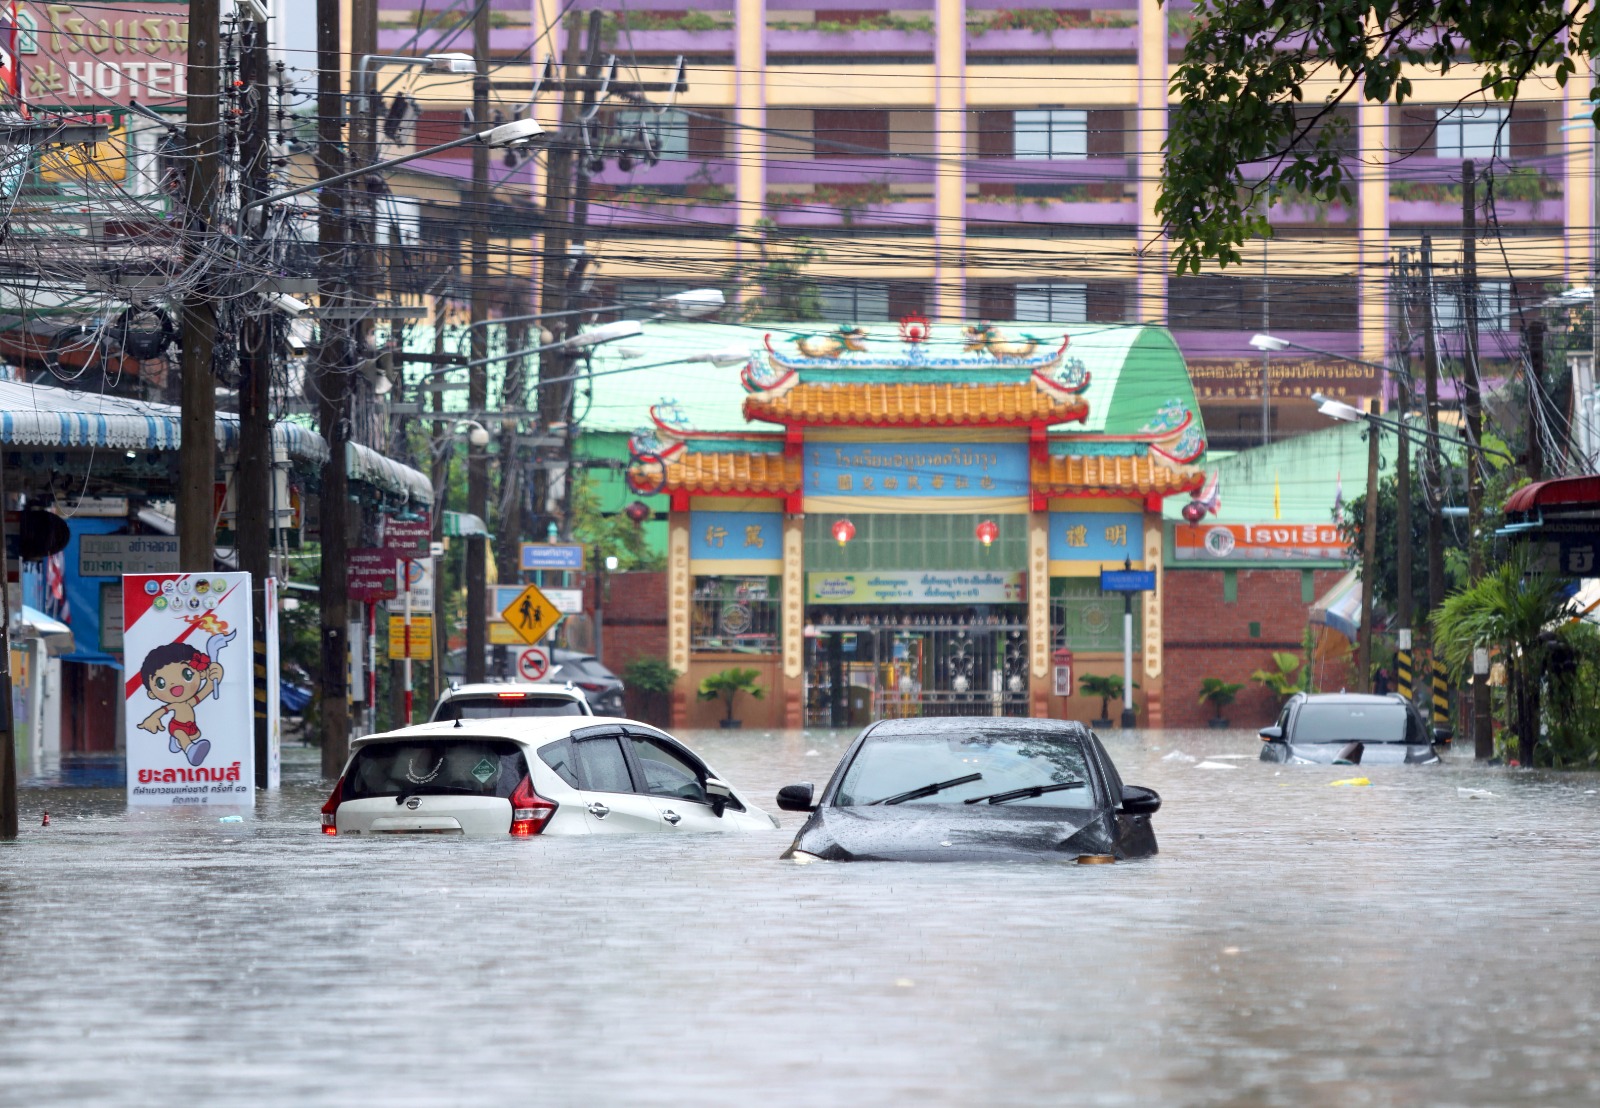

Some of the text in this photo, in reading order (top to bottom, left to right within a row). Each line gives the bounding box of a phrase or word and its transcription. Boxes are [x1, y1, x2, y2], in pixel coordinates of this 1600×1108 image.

[67, 61, 188, 99] HOTEL
[137, 762, 241, 784] ยะลาเกมส์
[132, 785, 209, 795] กีฬาเยาวชนแห่งชาติ
[210, 783, 234, 794] ครั้งที่
